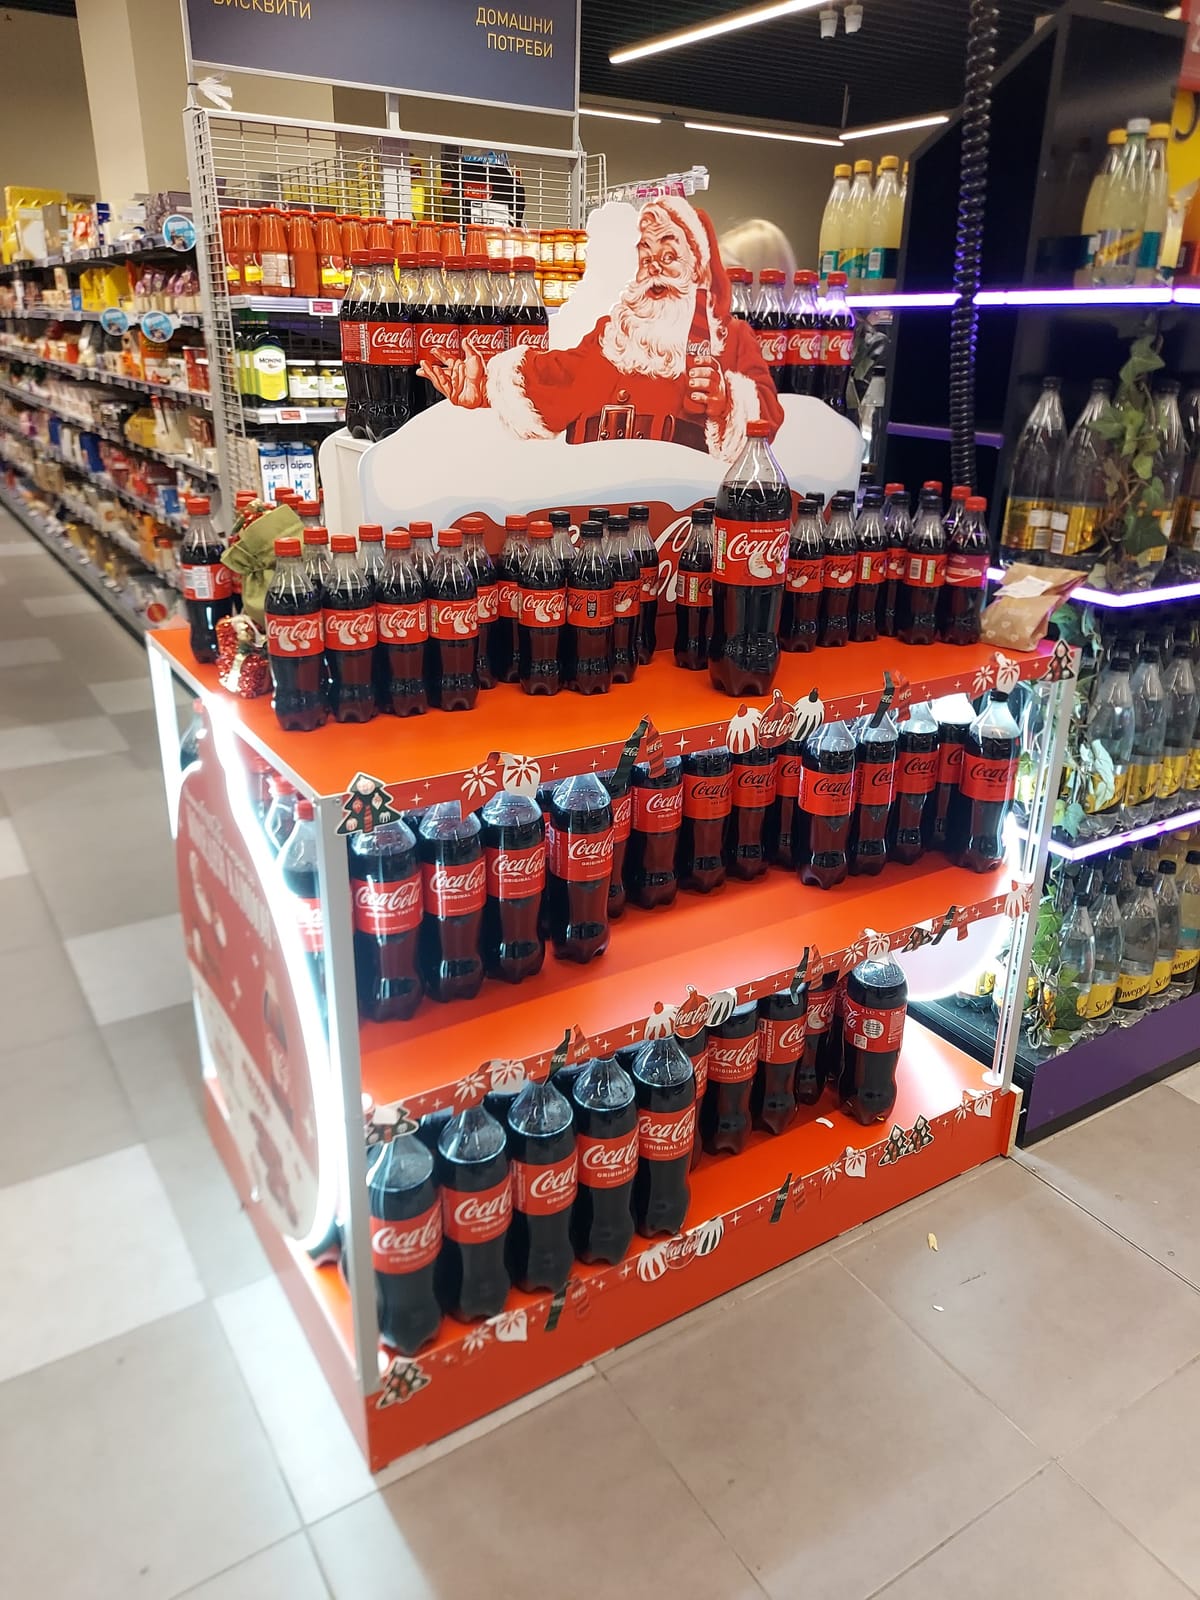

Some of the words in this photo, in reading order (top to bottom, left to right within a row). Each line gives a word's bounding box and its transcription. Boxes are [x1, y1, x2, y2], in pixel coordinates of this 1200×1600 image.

[475, 7, 553, 36] ДОМАШНИ
[487, 32, 553, 58] ПОТРЕБИ
[290, 460, 313, 471] alpro
